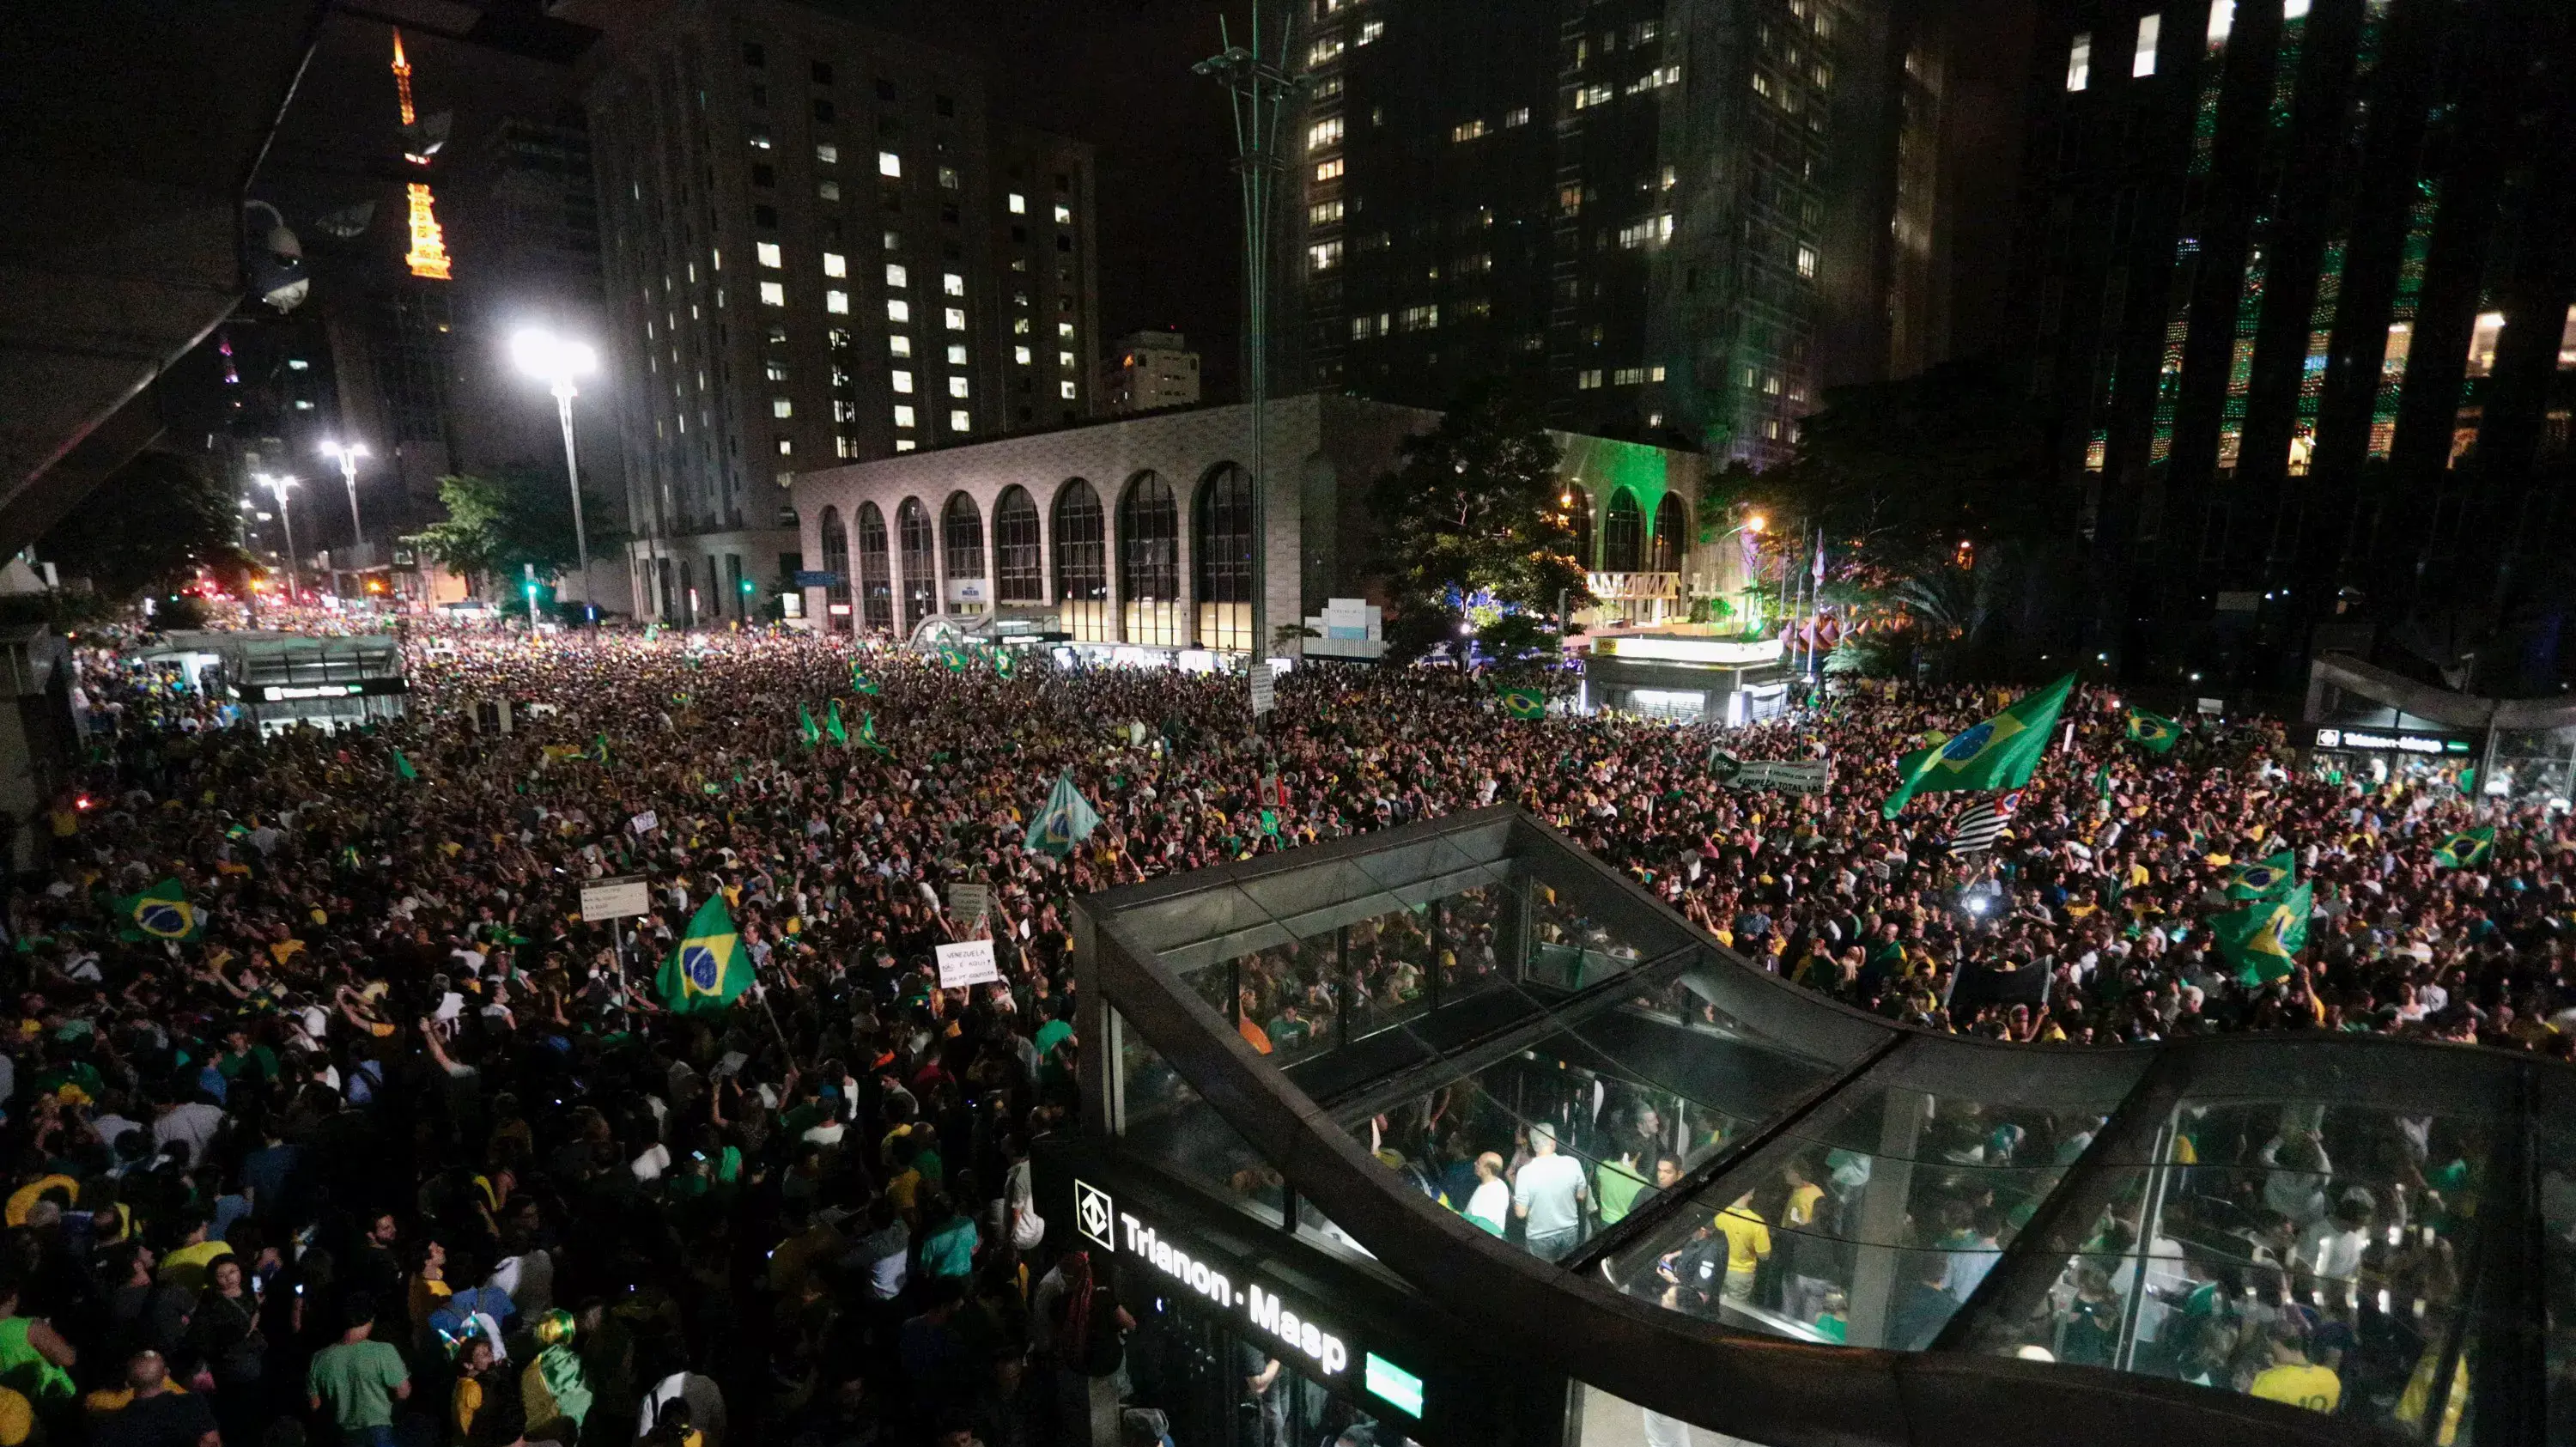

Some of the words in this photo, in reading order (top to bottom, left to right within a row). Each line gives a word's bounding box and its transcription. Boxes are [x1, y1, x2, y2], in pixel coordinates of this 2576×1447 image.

[947, 949, 985, 958] VENEZUELA
[1121, 1212, 1230, 1308] Trianon
[1250, 1284, 1346, 1375] Masp
